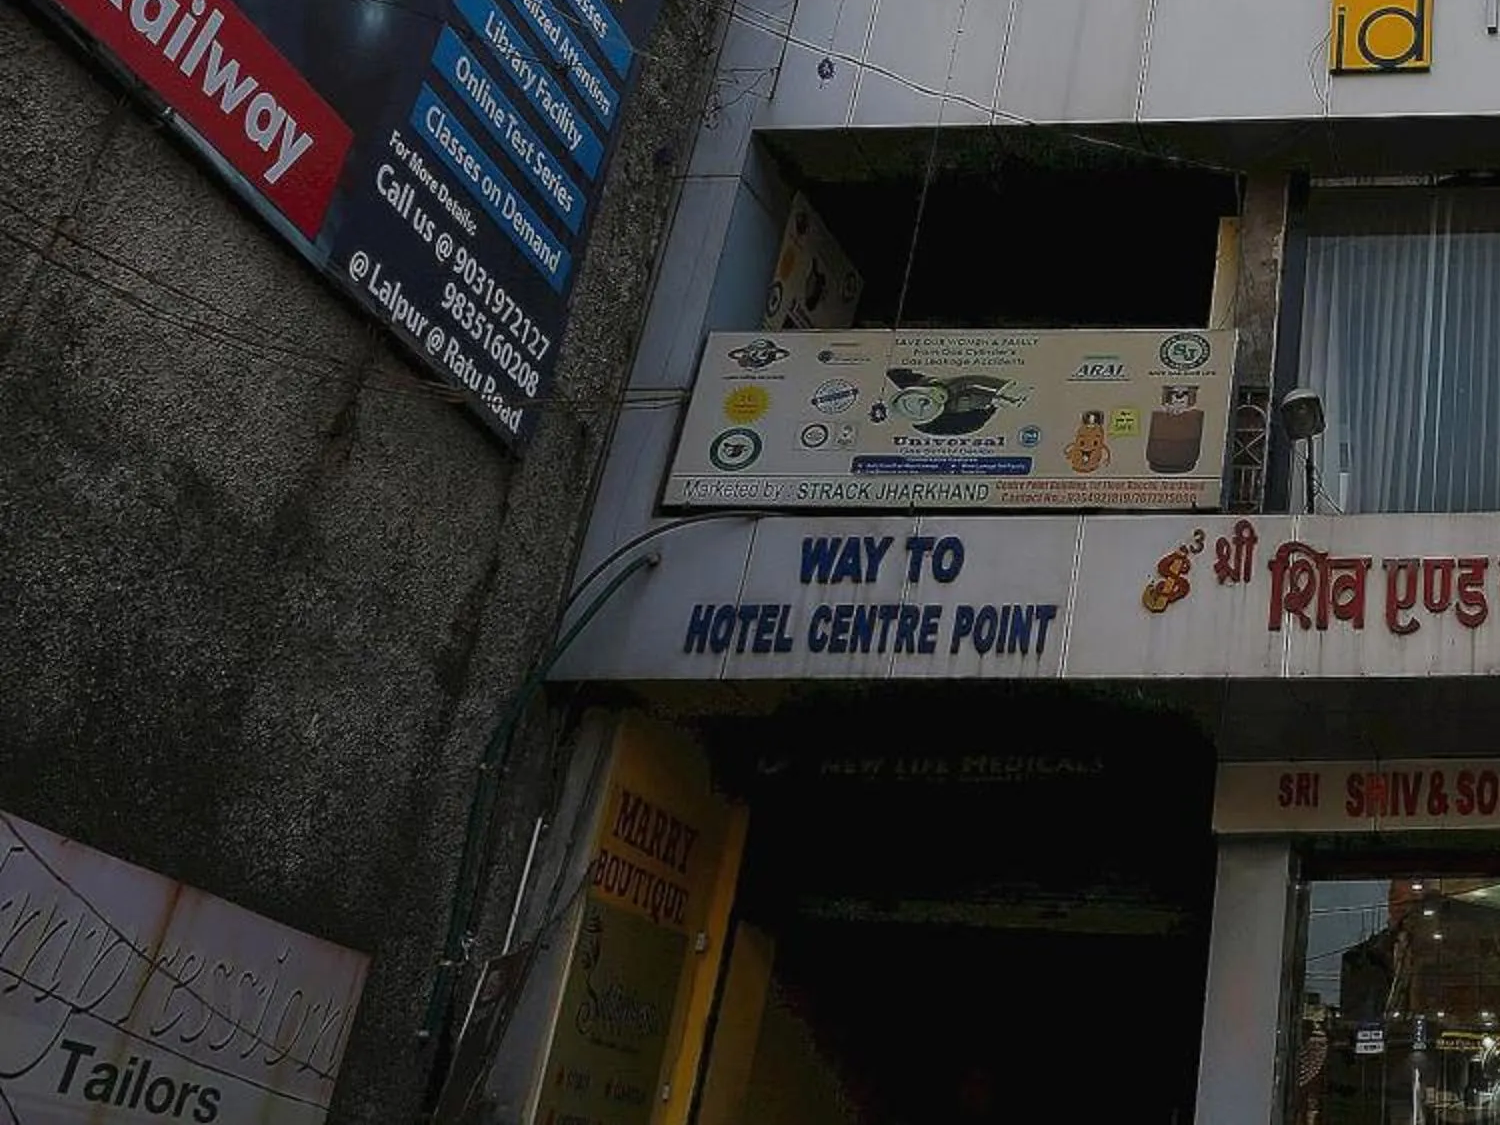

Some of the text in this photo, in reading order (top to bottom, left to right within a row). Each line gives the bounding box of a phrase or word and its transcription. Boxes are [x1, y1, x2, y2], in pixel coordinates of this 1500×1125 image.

[484, 11, 583, 152] Library Facility
[389, 130, 411, 161] For
[408, 154, 438, 194] More
[455, 56, 574, 213] Online Test Series
[426, 105, 562, 275] Classes on Demand
[376, 164, 551, 362] Call us @ 9031972127
[350, 250, 524, 434] @ Lalpur @ Ratu Road
[441, 282, 540, 399] 9835160208
[893, 436, 1005, 447] Universal
[682, 479, 990, 502] Marketed by STRACK JHARKHAND
[800, 536, 965, 586] WAY TO
[1214, 519, 1258, 585] श्री
[1268, 541, 1373, 633] शिव
[1382, 557, 1489, 635] एण्ड
[683, 604, 1058, 656] HOTEL CENTRE POINT
[612, 789, 700, 875] MARRY
[1279, 774, 1320, 808] SRI
[592, 849, 690, 925] BOUTIQUE
[0, 848, 354, 1080] mpression
[56, 1039, 223, 1124] Tailors
